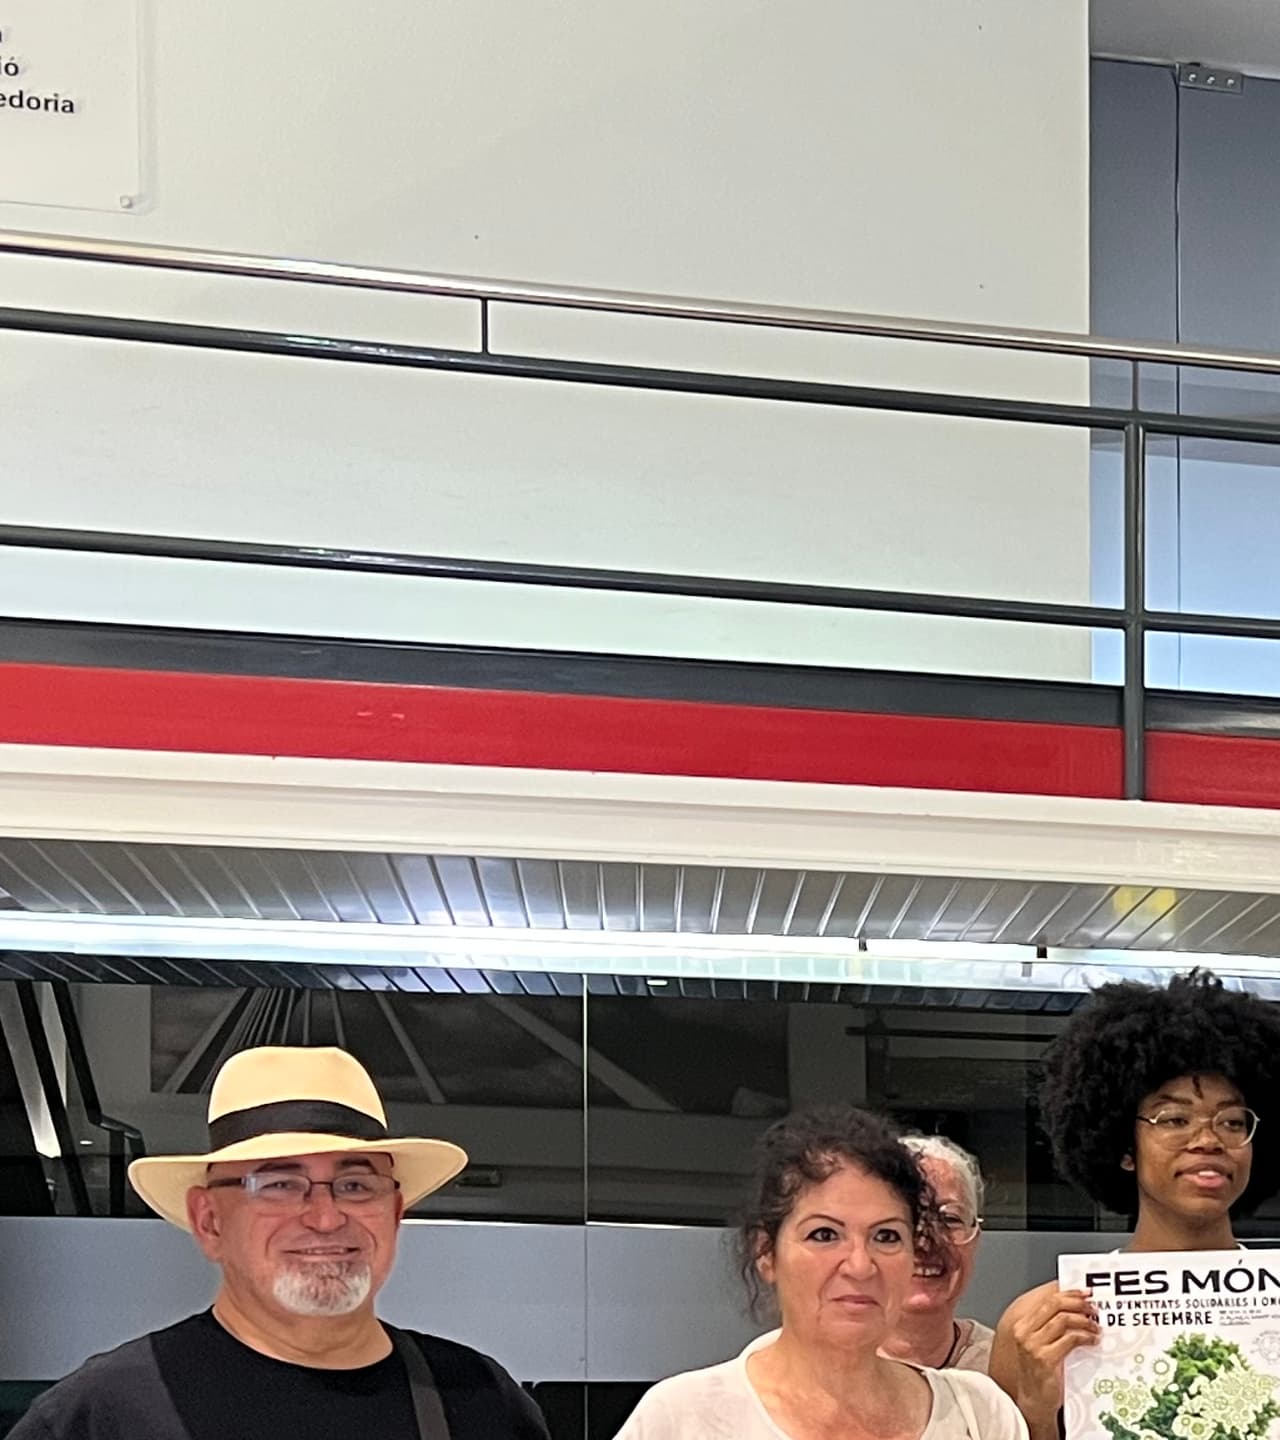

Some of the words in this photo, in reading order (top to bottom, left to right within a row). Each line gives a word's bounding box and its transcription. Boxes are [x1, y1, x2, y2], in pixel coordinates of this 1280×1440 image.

[1086, 1271, 1170, 1297] FES
[1115, 1299, 1181, 1310] D'ENTITATS
[1106, 1312, 1127, 1328] DE
[1132, 1310, 1213, 1327] SETEMBRE
